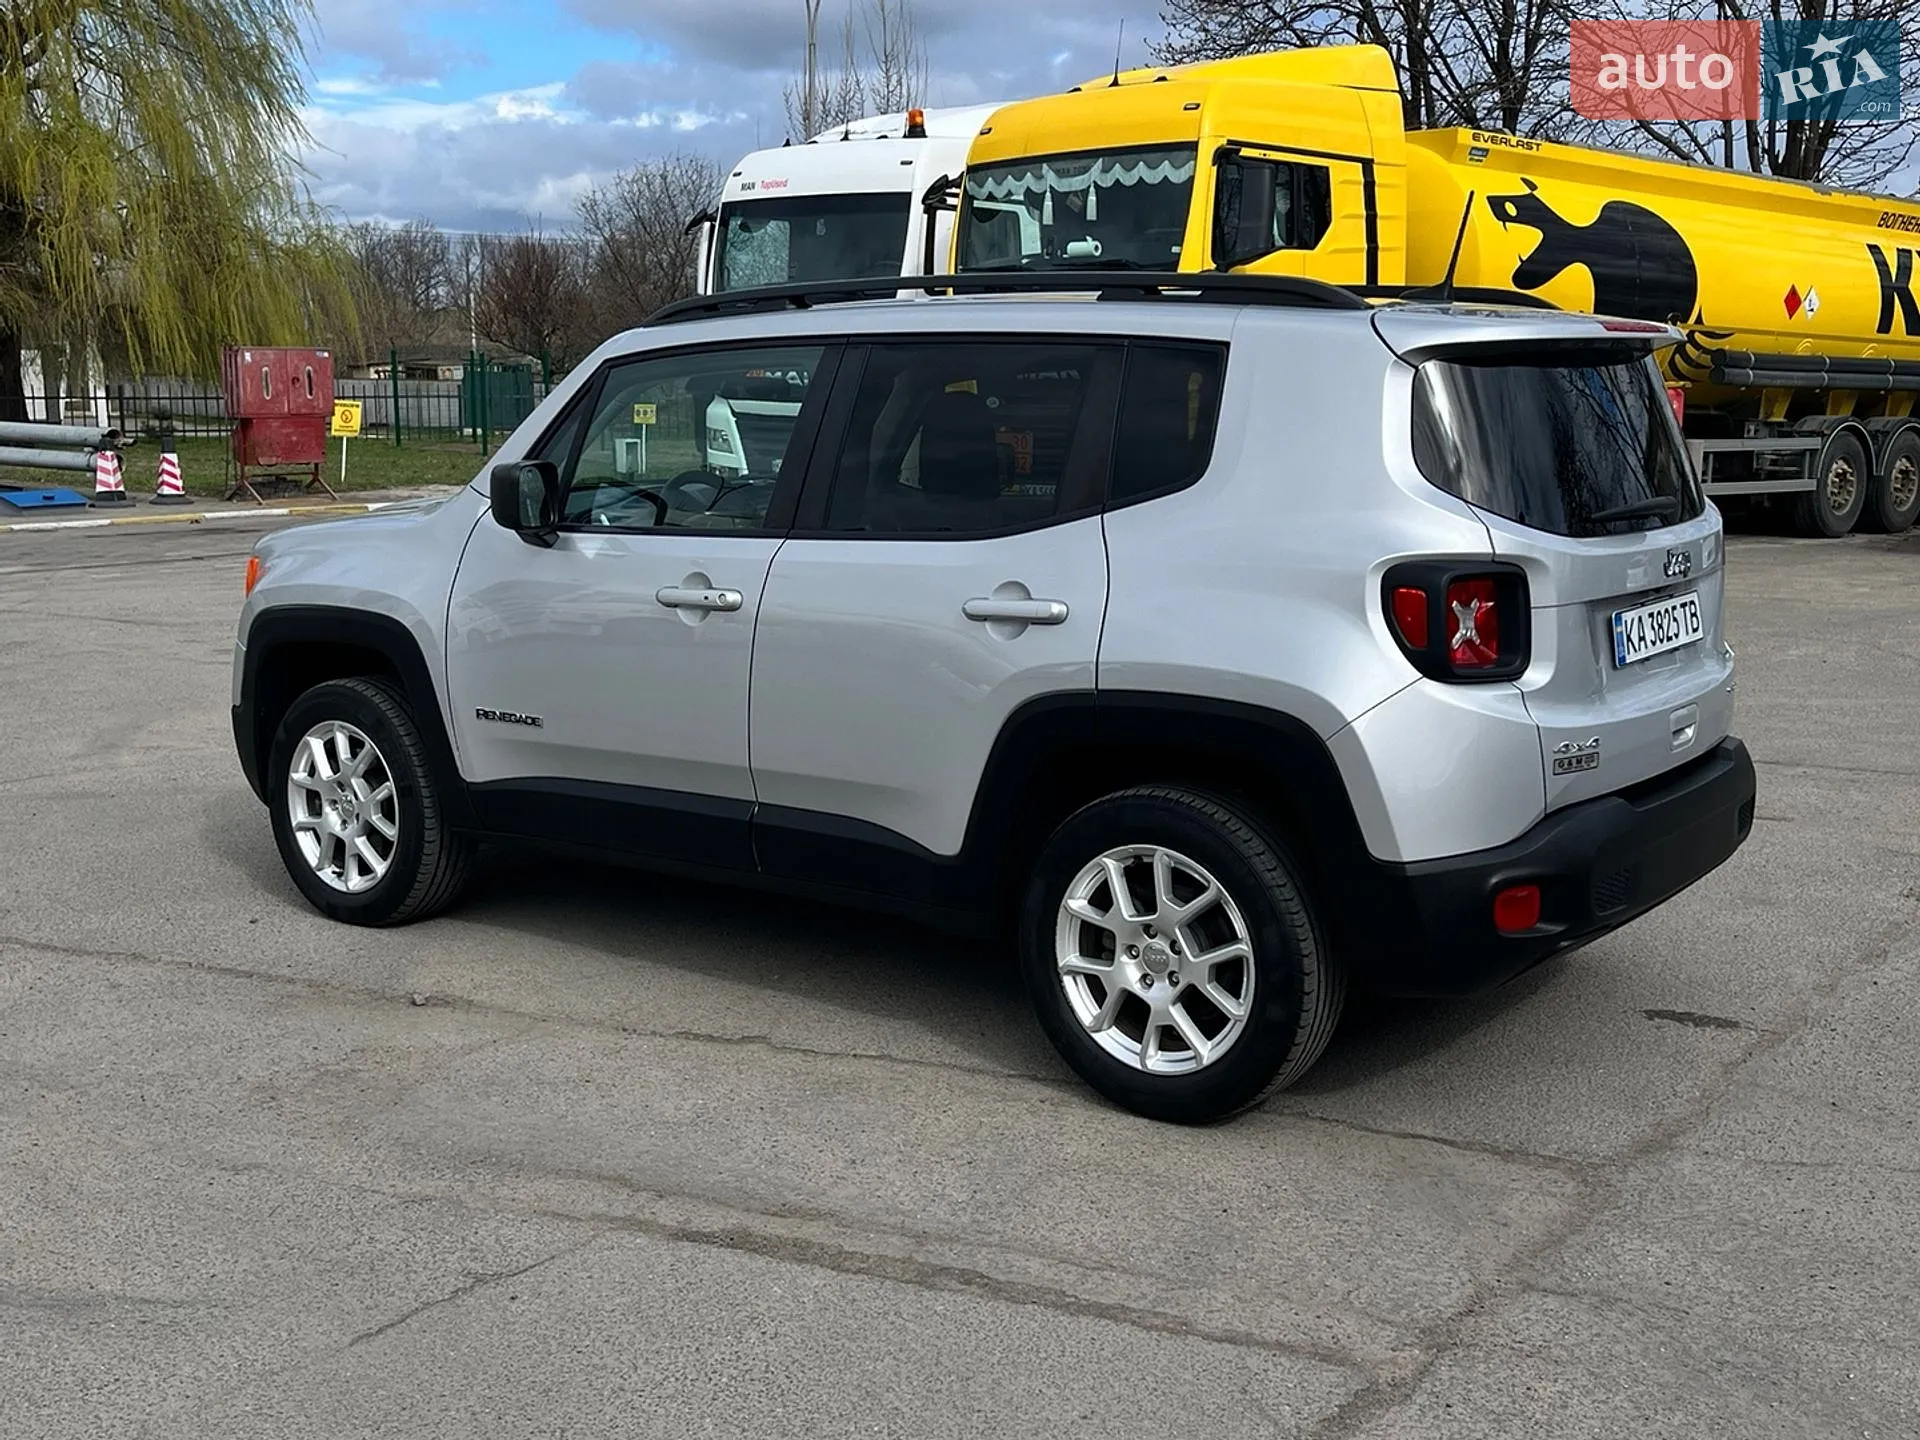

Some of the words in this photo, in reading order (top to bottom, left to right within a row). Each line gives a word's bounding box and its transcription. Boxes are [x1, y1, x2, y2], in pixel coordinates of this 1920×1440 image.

[1471, 132, 1543, 152] EVERLAST
[740, 181, 756, 191] MAN
[1865, 242, 1920, 336] K
[1624, 615, 1648, 656] KA
[1648, 604, 1680, 647] 3825
[1680, 600, 1700, 637] TB
[475, 708, 544, 729] RENEGADE
